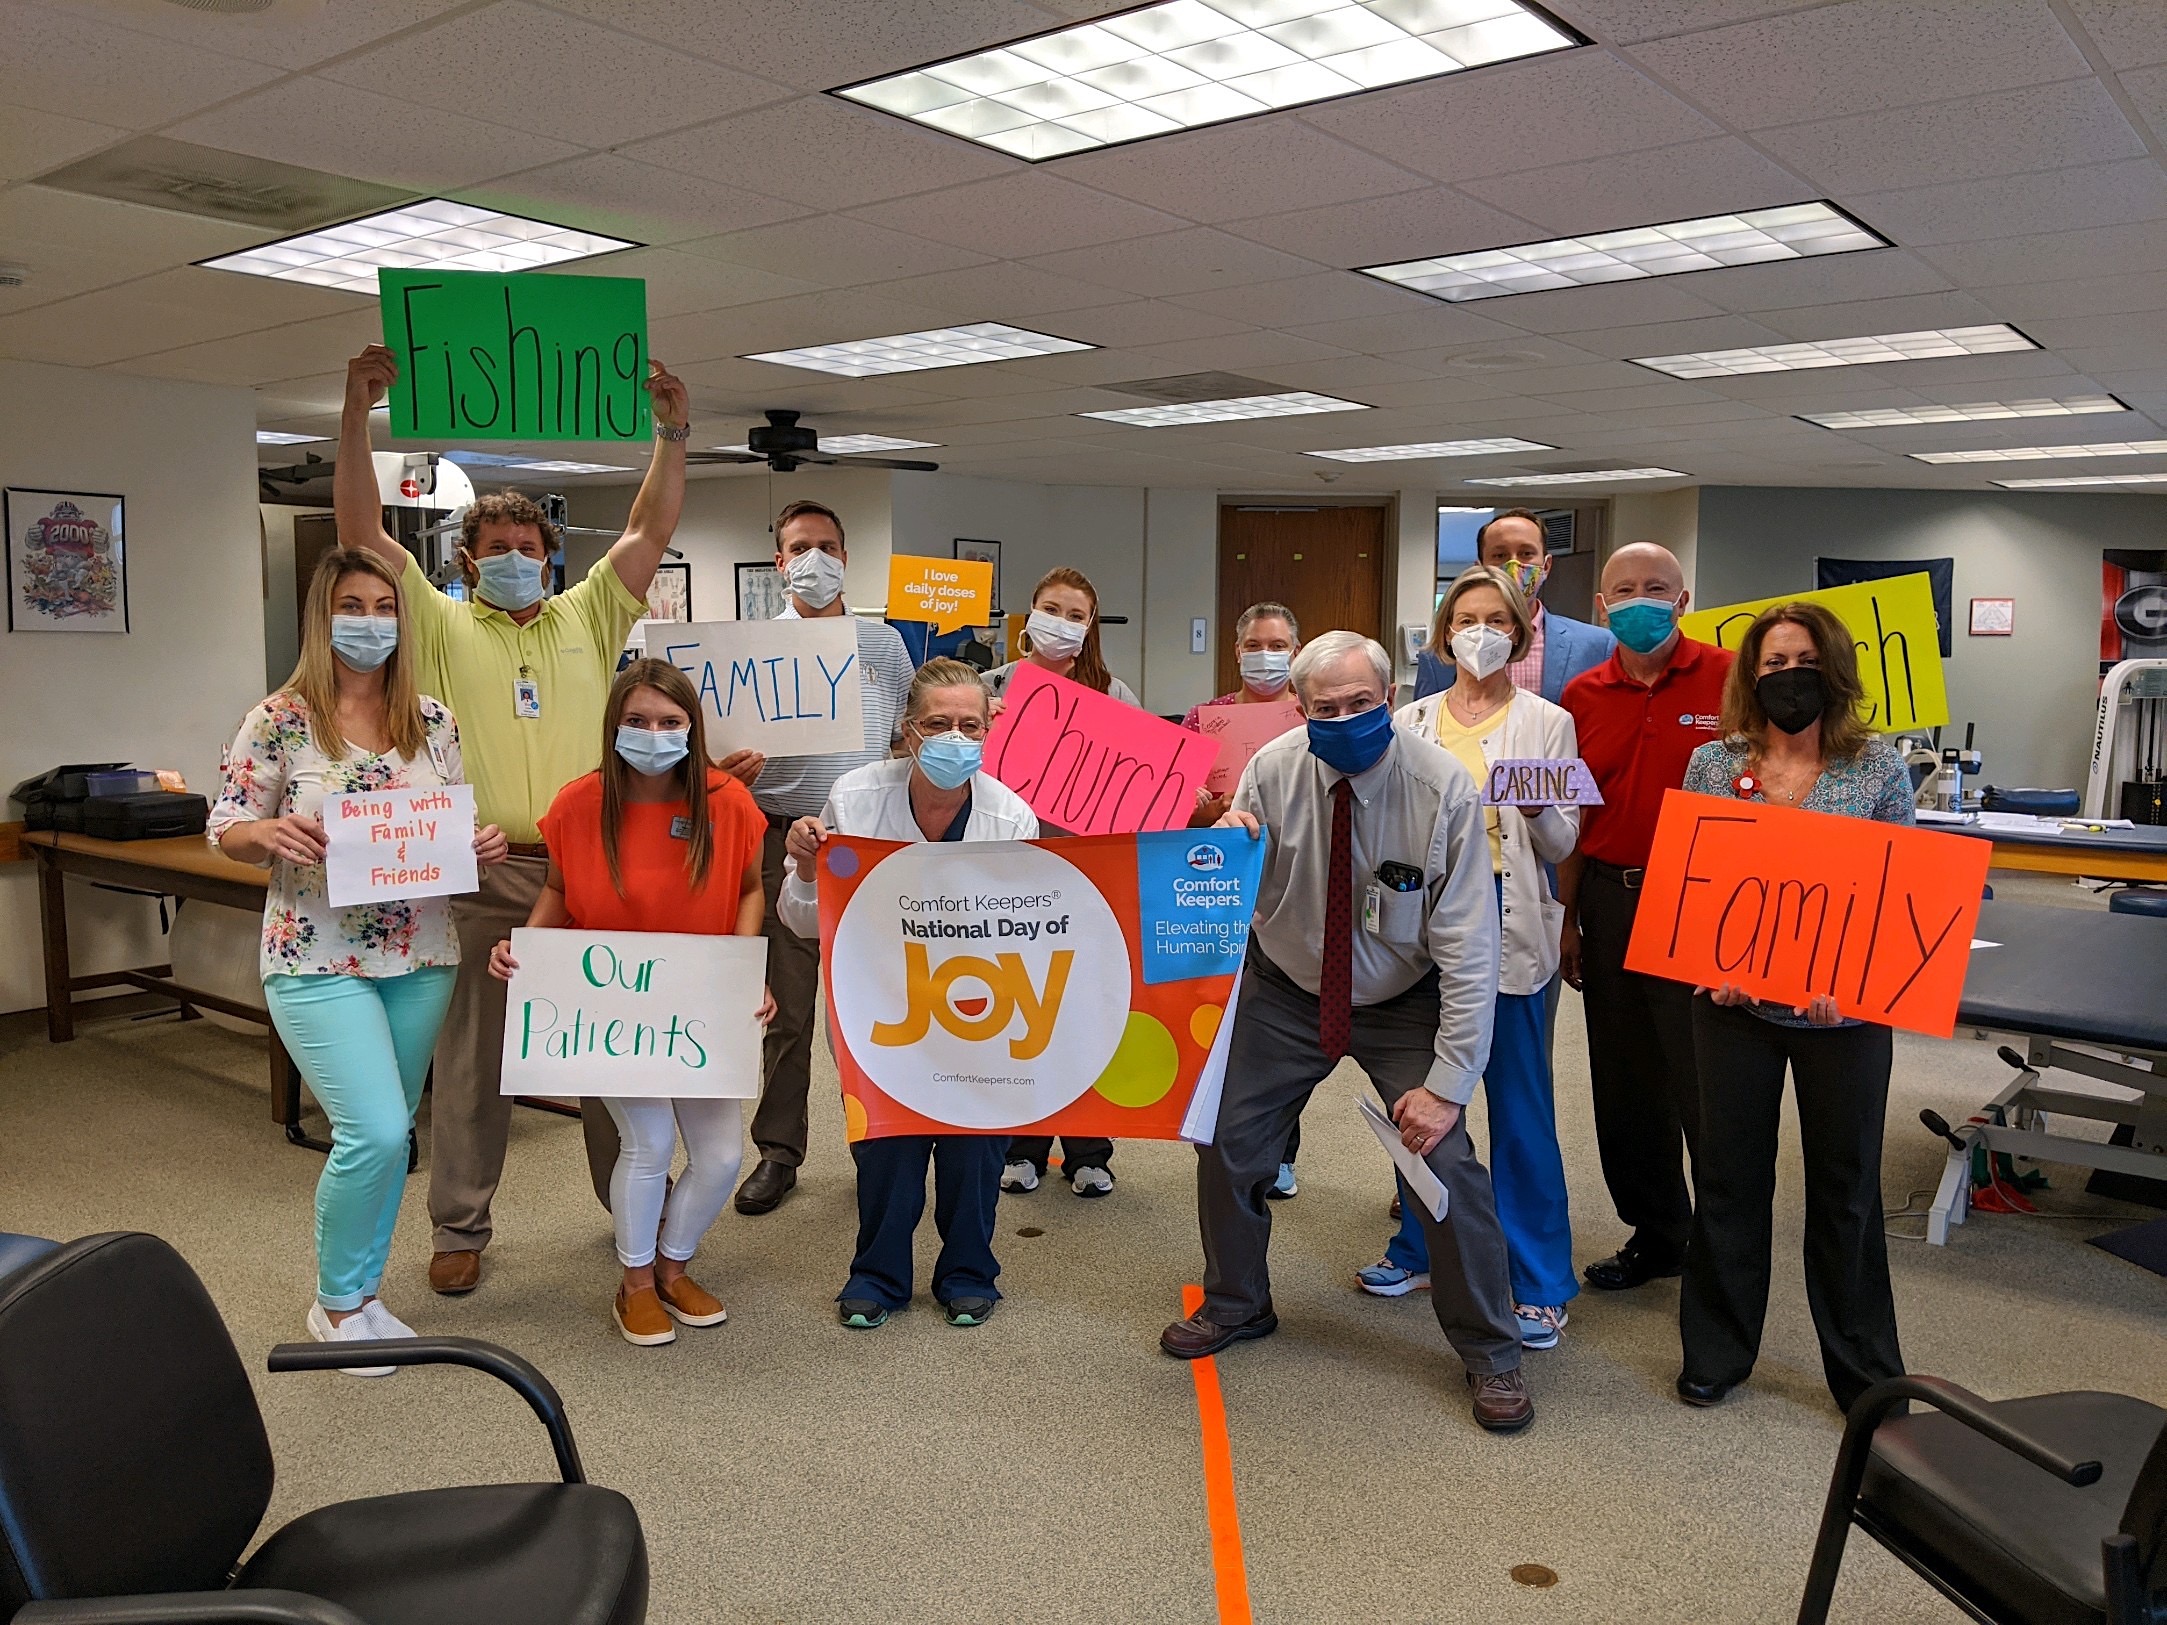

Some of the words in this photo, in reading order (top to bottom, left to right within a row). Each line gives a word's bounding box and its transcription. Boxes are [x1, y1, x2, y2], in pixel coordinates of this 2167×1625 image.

[403, 284, 639, 438] Fishing
[50, 523, 89, 545] 2000
[924, 568, 929, 580] I
[931, 569, 959, 582] love
[904, 582, 936, 598] daily
[938, 585, 976, 599] doses
[920, 598, 935, 609] of
[934, 600, 959, 614] joy!
[667, 643, 855, 722] FAMILY
[2095, 696, 2108, 760] NAUTILUS
[997, 684, 1185, 834] Church
[1490, 765, 1580, 802] CARING
[341, 799, 393, 819] Being
[409, 791, 452, 812] with
[371, 819, 436, 842] Family
[371, 863, 441, 886] Friends
[1173, 877, 1240, 892] Comfort
[899, 896, 971, 912] Comfort
[1668, 816, 1963, 1014] Family
[901, 918, 991, 939] National
[998, 918, 1041, 940] Day
[1045, 914, 1069, 934] of
[1155, 920, 1229, 938] Elevating
[1156, 940, 1215, 954] Human
[582, 944, 667, 993] Our
[521, 998, 708, 1069] Patients
[932, 1072, 1035, 1086] ComfortKeepers.com
